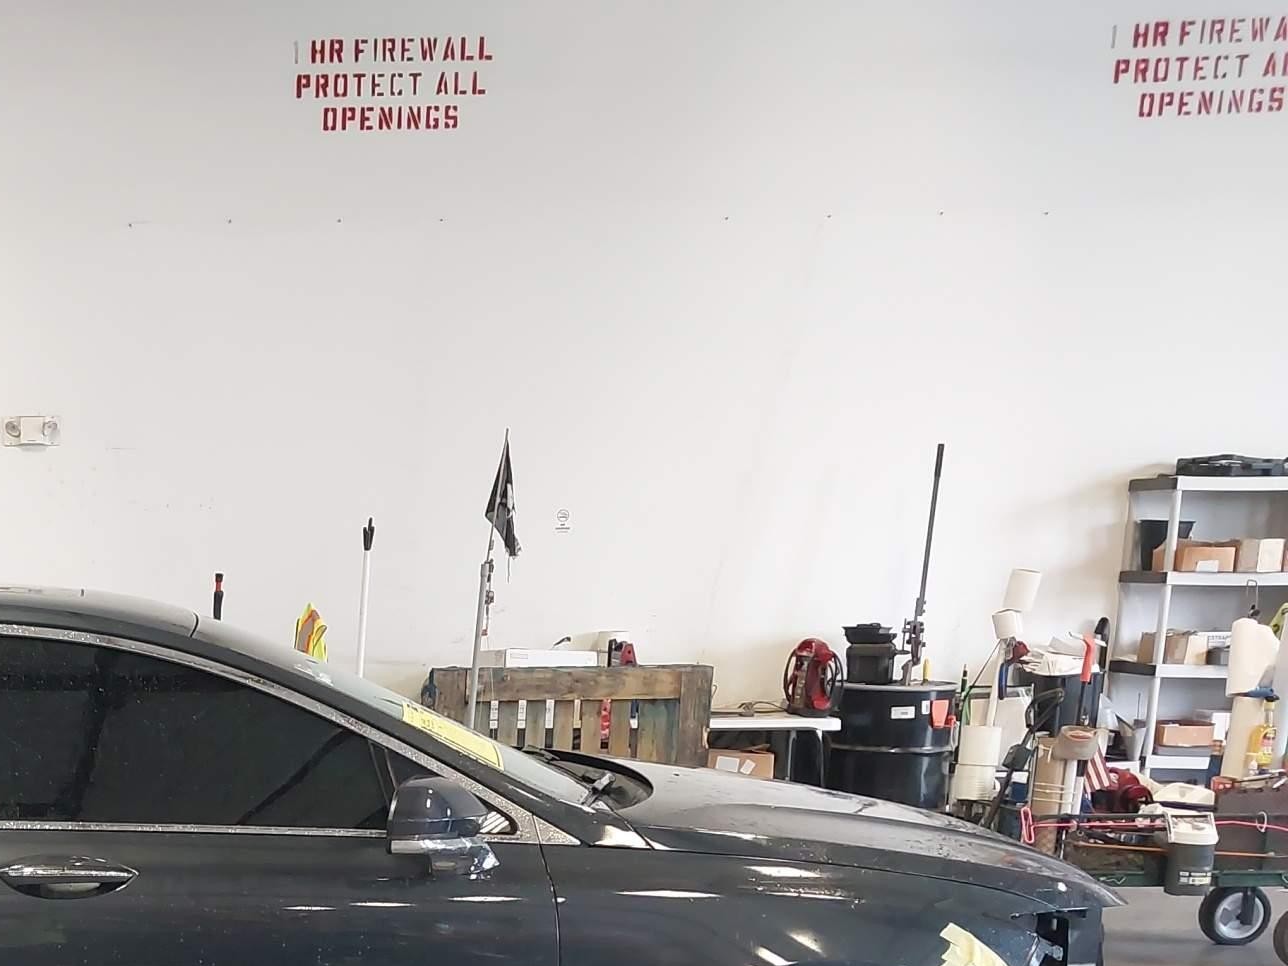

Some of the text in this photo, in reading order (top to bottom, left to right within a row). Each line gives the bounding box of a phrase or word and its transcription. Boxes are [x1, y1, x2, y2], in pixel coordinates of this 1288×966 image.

[1132, 20, 1170, 48] HR
[310, 38, 345, 64] HR
[354, 36, 493, 63] FIREWALL
[1113, 53, 1250, 84] PROTECT
[295, 70, 486, 99] PROTECT ALL
[1138, 86, 1285, 118] OPENINGS
[322, 105, 459, 132] OPENINGS
